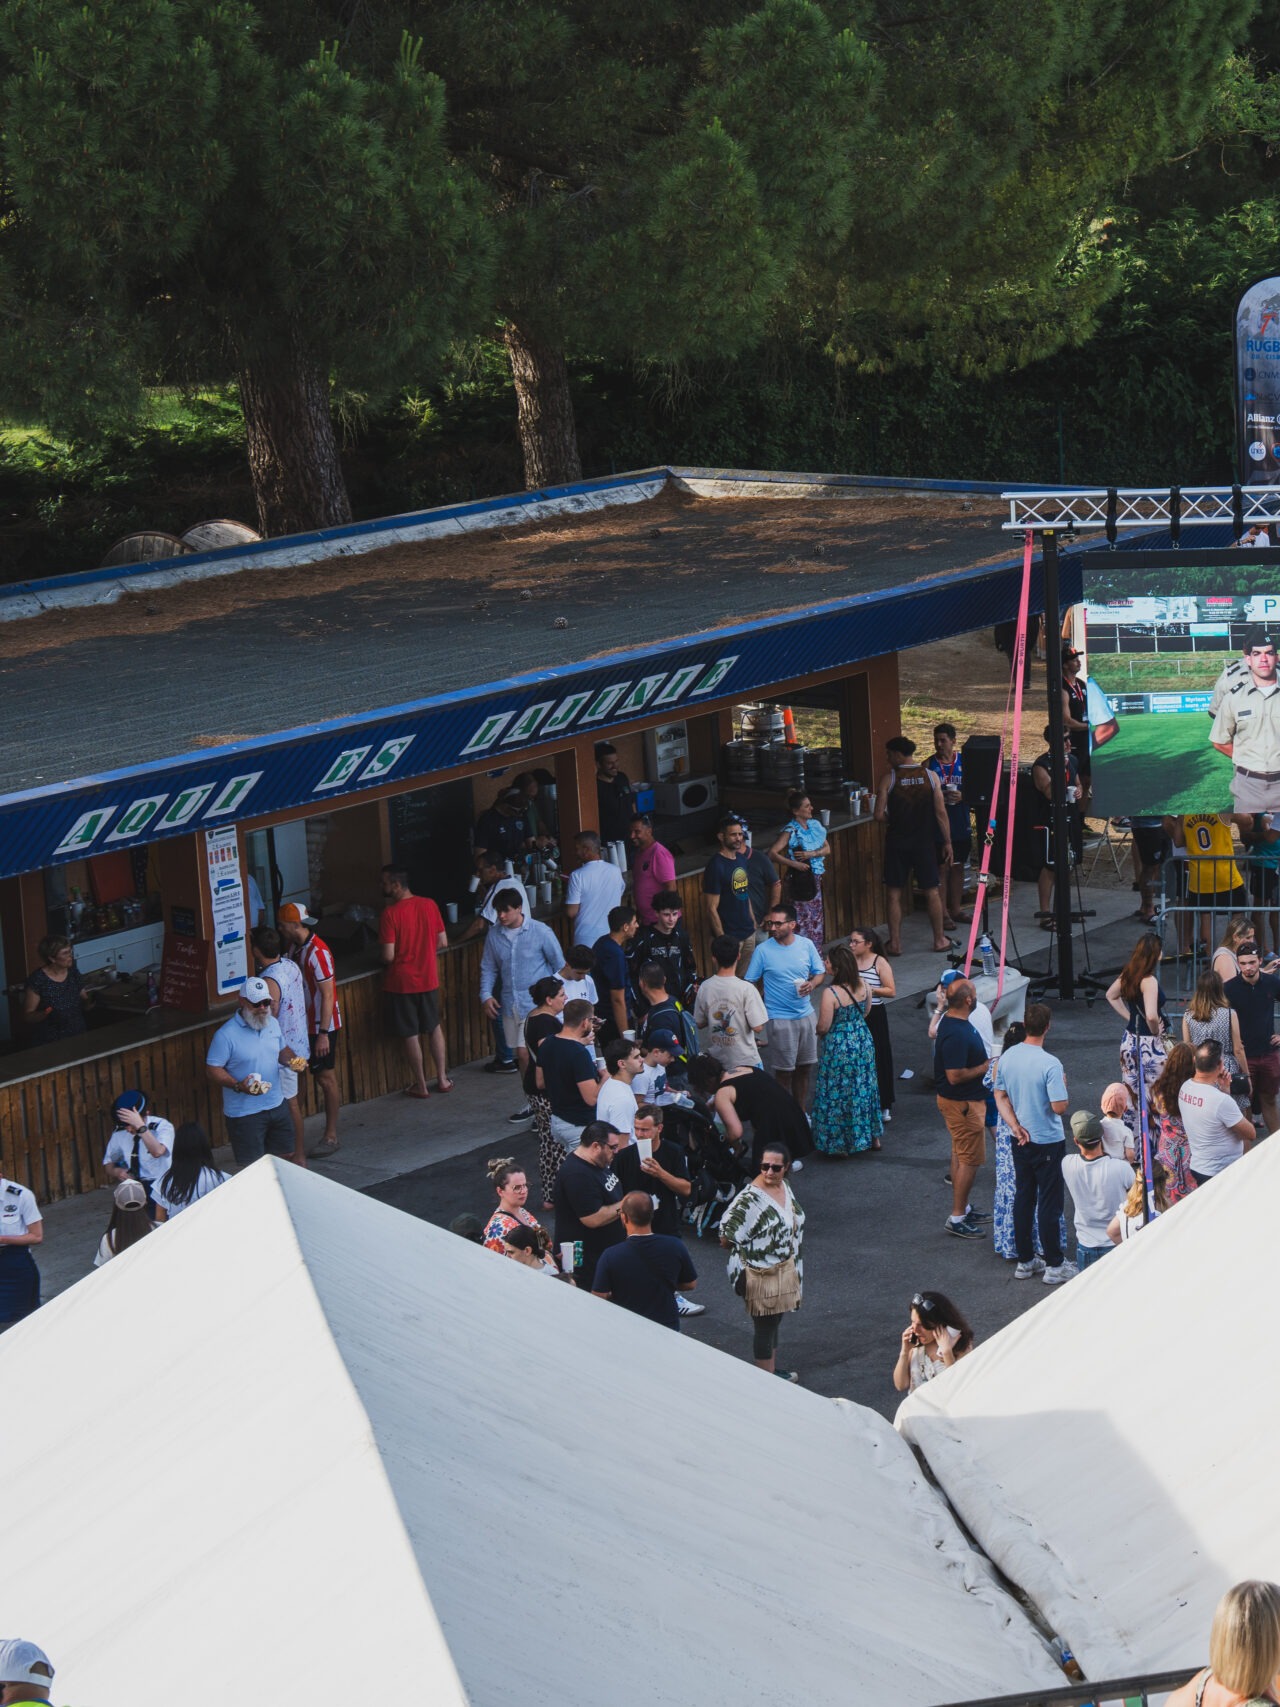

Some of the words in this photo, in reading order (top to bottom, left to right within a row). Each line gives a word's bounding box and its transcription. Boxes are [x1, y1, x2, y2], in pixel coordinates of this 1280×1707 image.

[1247, 413, 1276, 423] Allianz
[1264, 599, 1277, 614] P
[59, 776, 254, 850] AQUI
[319, 740, 408, 787] ES
[465, 658, 734, 750] LAJUNIE
[1196, 826, 1212, 851] 0
